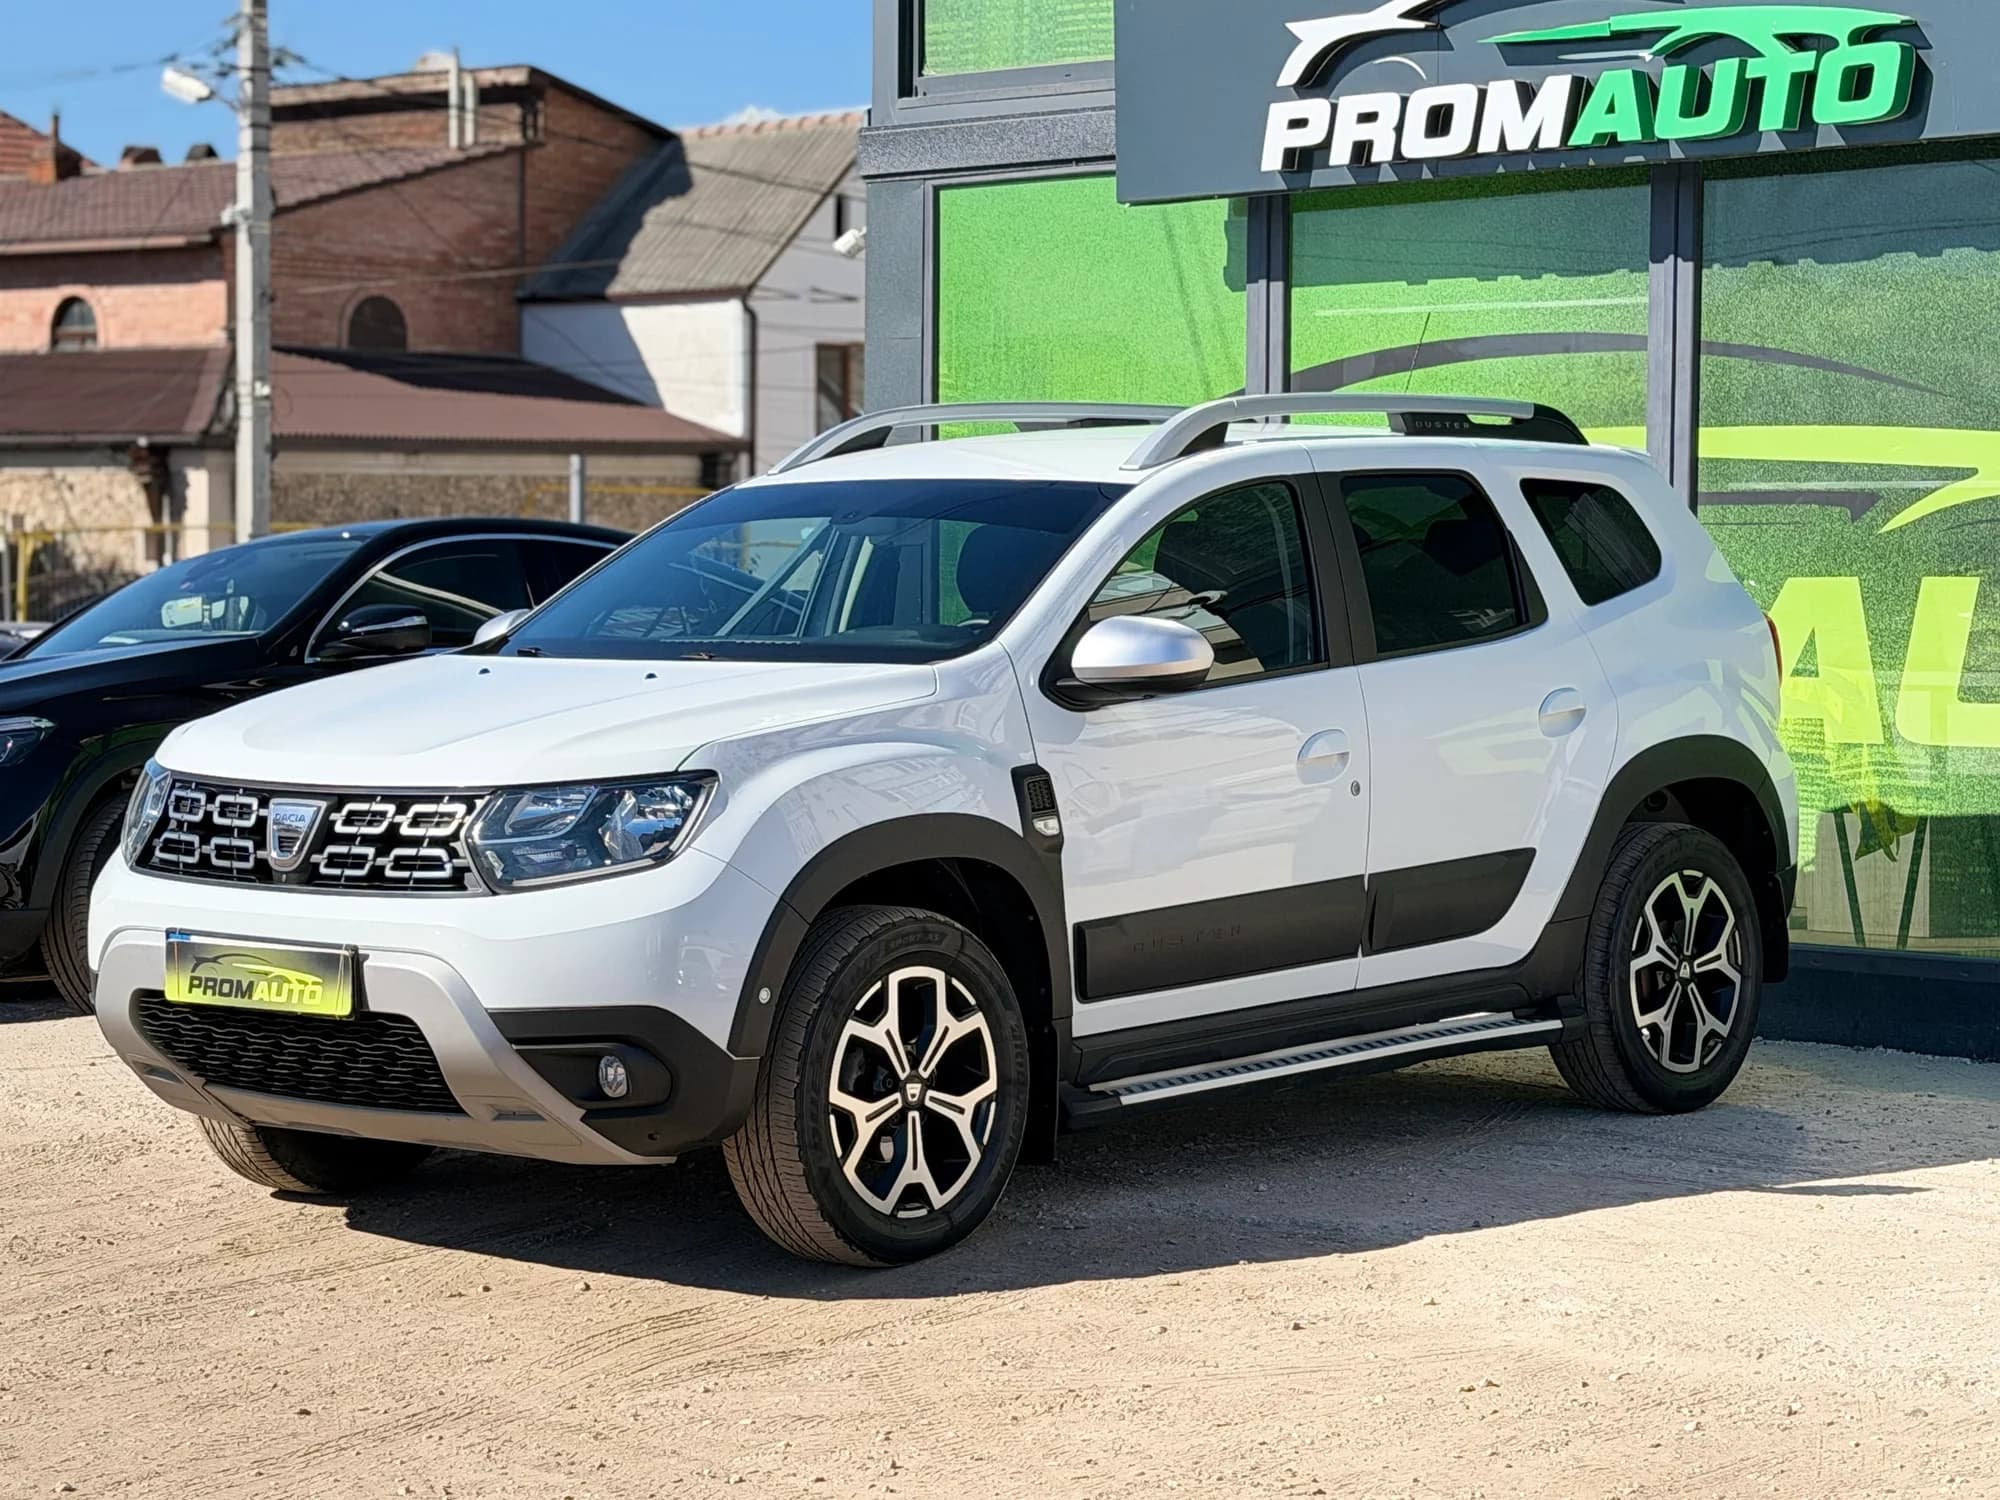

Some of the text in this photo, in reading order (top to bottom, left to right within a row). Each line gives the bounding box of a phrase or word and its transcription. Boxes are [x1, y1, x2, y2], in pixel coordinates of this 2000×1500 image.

[1259, 42, 1913, 172] PROMAUTO
[1415, 420, 1470, 429] DUSTER
[274, 813, 306, 823] DACIA
[187, 975, 324, 1006] PROMAUTO
